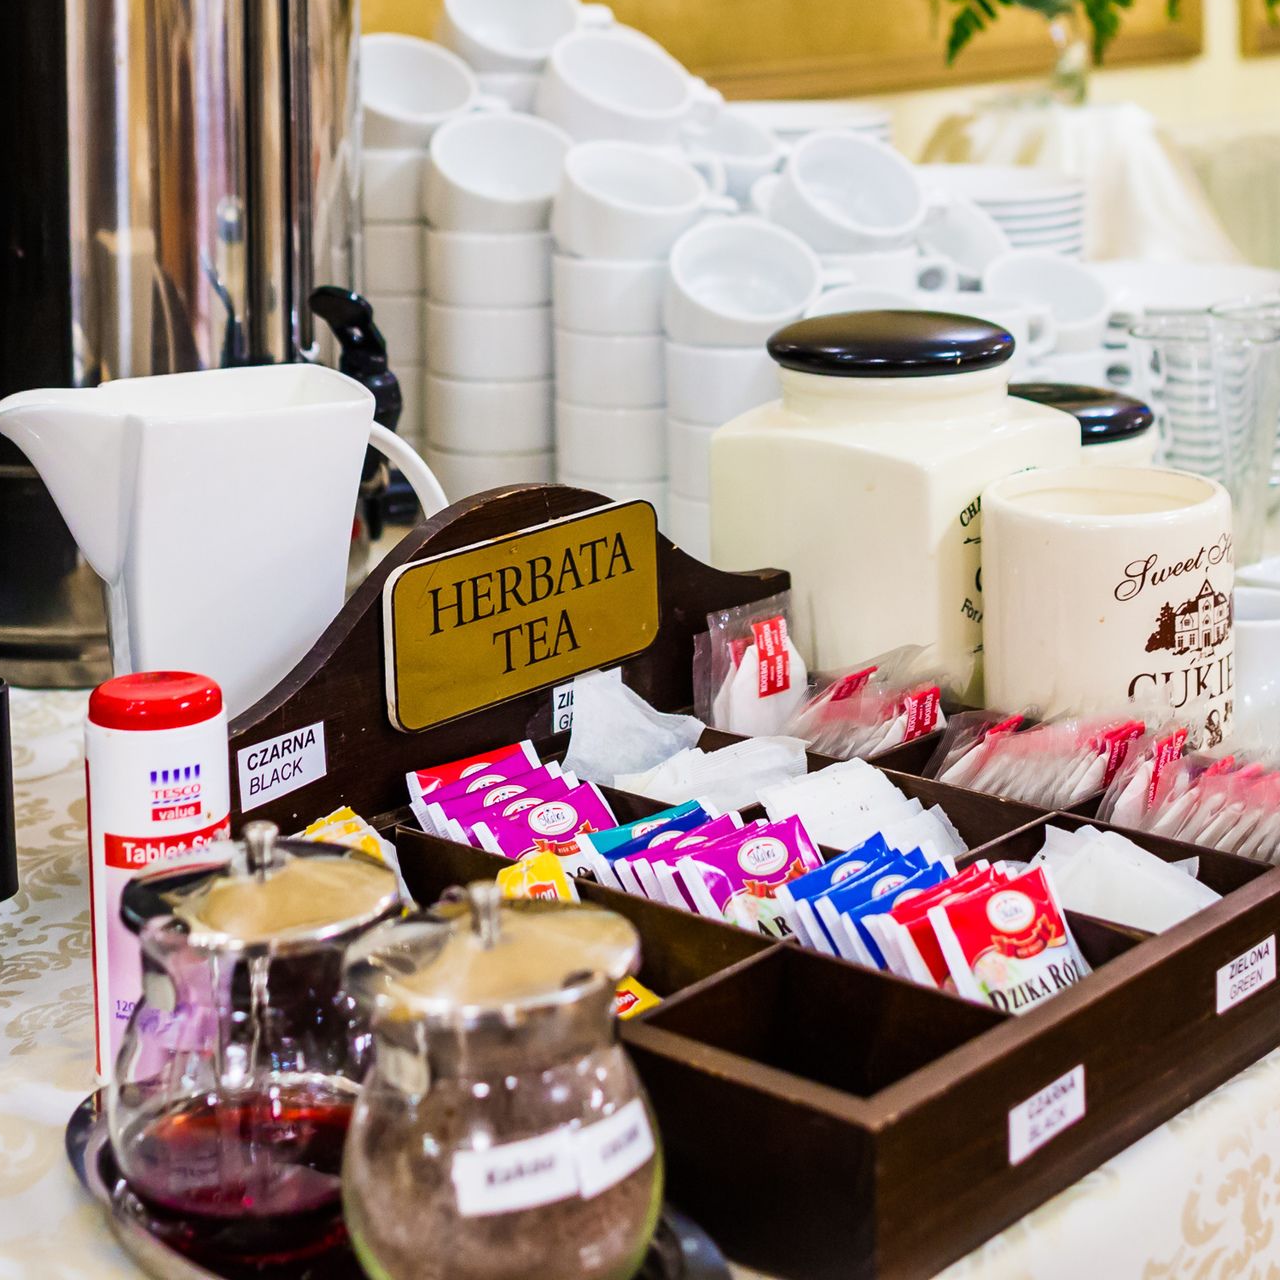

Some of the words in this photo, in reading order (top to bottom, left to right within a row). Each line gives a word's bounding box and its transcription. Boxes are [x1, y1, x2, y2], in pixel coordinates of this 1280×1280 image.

[427, 532, 635, 637] HERBATA
[1114, 546, 1207, 602] Sweet
[491, 608, 582, 675] TEA
[247, 728, 316, 771] CZARNA
[152, 783, 201, 800] TESCO
[249, 756, 303, 796] BLACK
[158, 805, 196, 821] value
[122, 840, 186, 864] Tablet
[1228, 942, 1271, 980] ZIELONA
[987, 975, 1052, 1015] DZIKA
[1229, 967, 1264, 1001] GREEN
